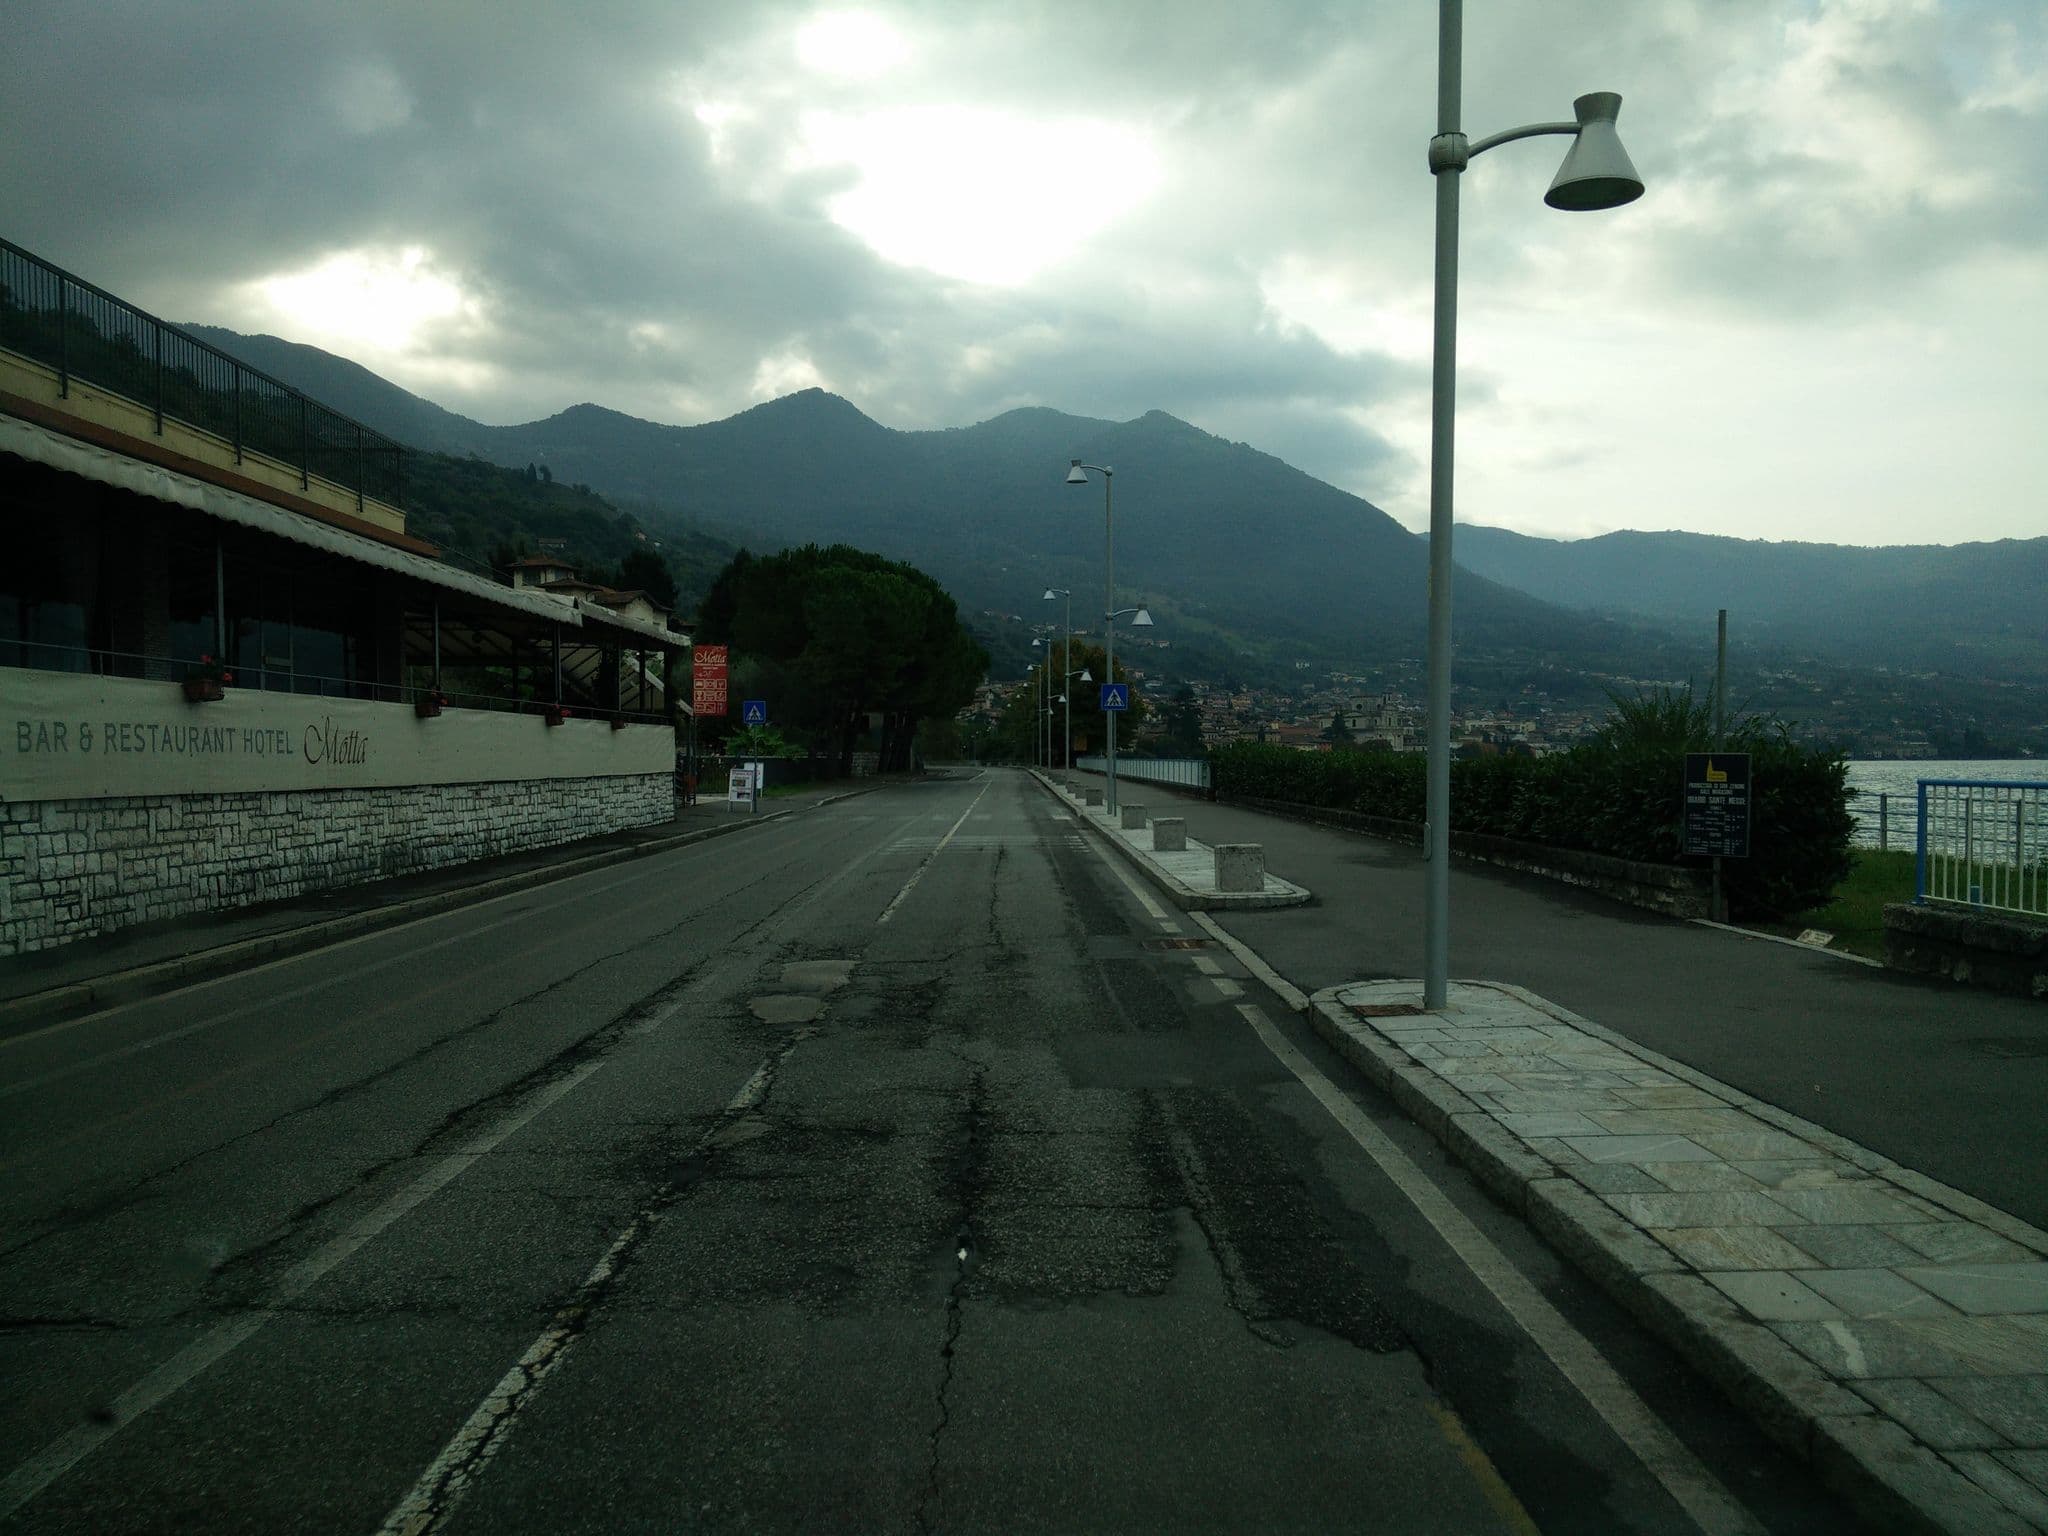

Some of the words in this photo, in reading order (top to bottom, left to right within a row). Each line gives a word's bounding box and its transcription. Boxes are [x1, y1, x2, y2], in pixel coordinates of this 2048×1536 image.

[16, 721, 68, 753] BAR
[79, 722, 93, 753] &
[104, 723, 235, 754] RESTAURANT
[243, 729, 293, 755] HOTEL
[304, 716, 369, 765] Motta
